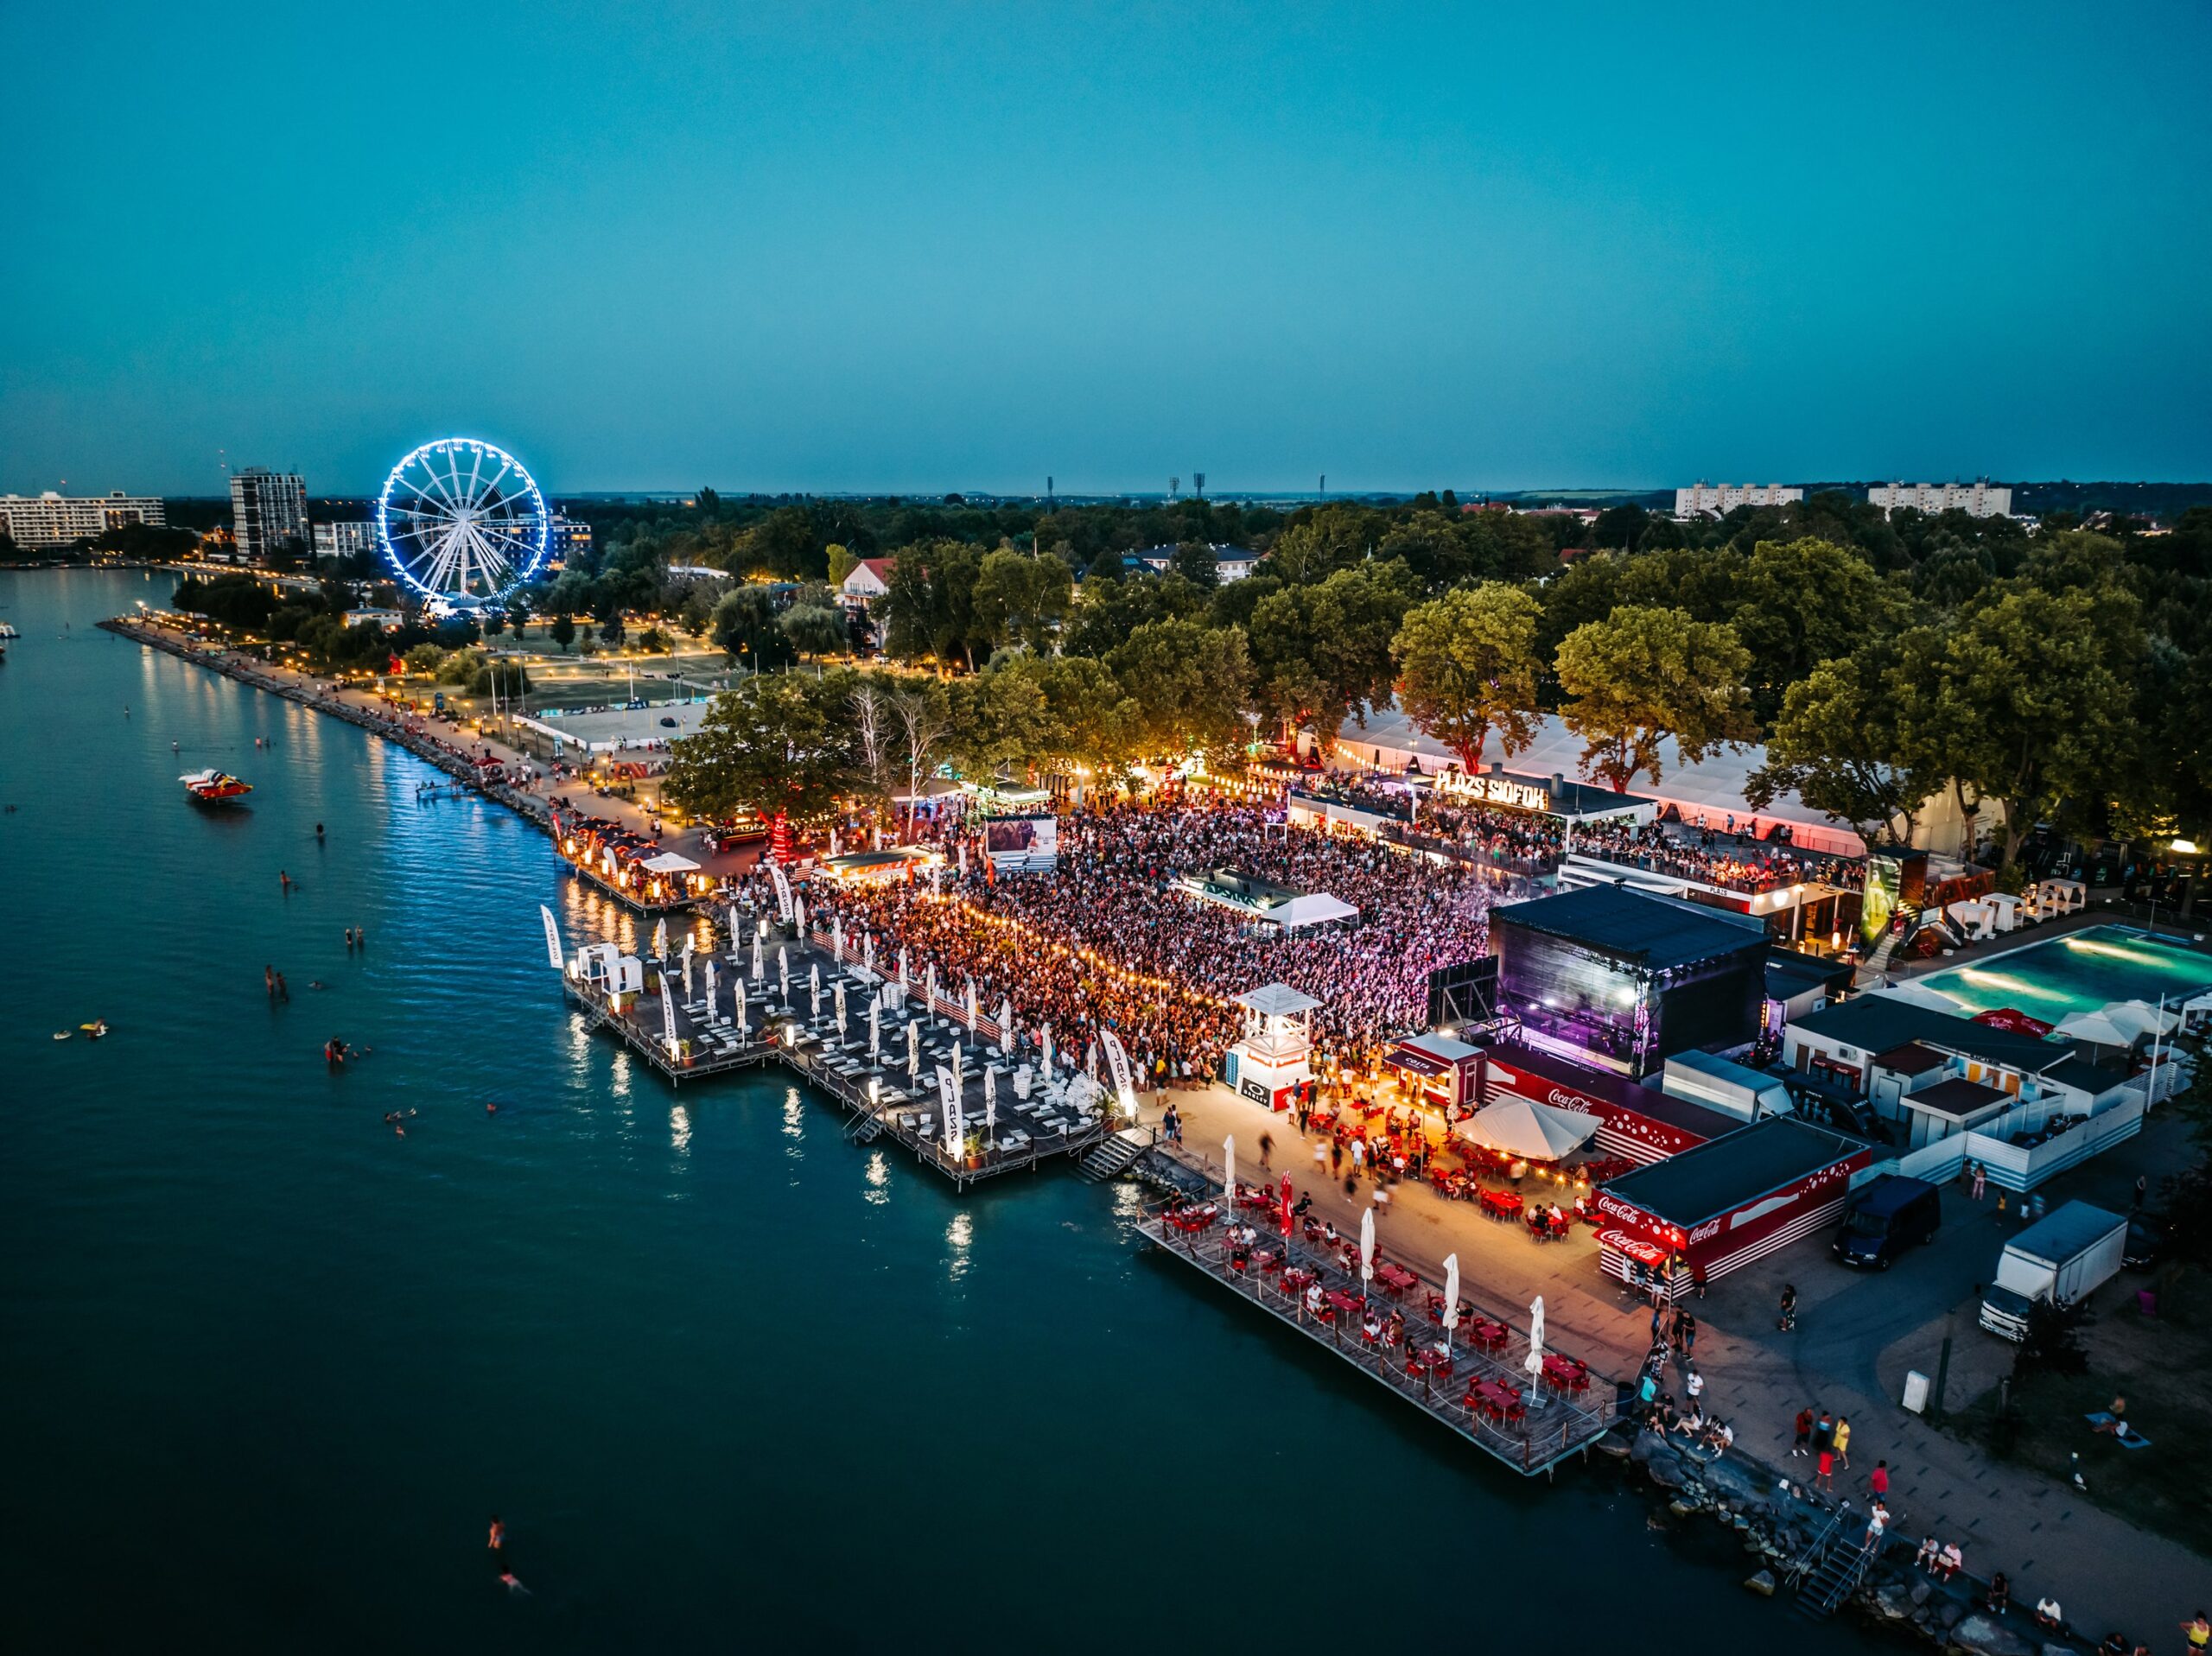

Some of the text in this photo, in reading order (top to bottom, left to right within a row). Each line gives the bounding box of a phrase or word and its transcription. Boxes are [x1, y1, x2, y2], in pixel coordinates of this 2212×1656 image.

[1405, 1057, 1431, 1069] COSTA
[1243, 1089, 1268, 1104] OAKLEY
[1548, 1088, 1592, 1114] Coca-Cola
[1599, 1196, 1640, 1224] Coca-Cola
[1599, 1229, 1662, 1260] Coca-Cola
[1688, 1218, 1721, 1245] Coca-Cola
